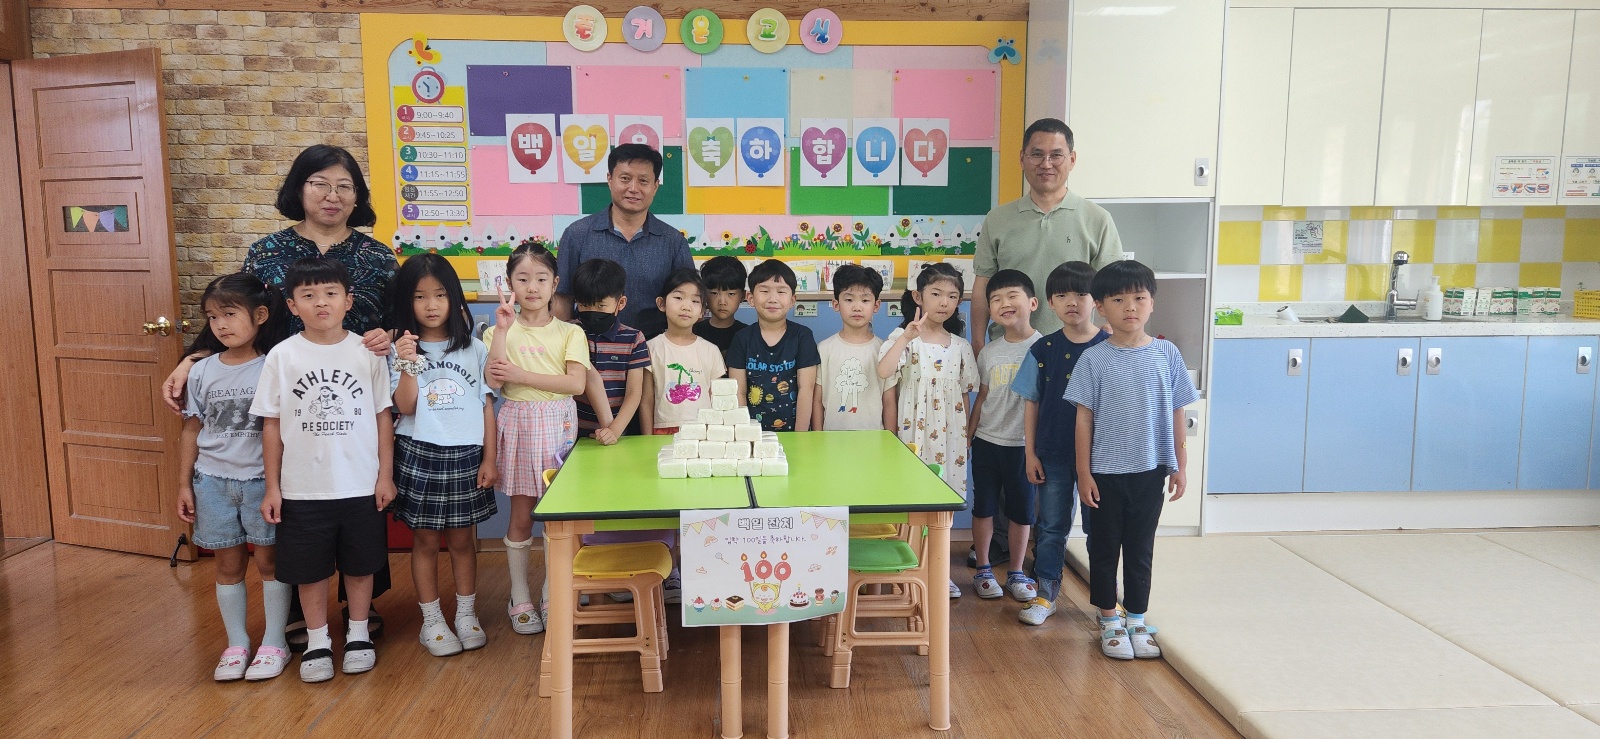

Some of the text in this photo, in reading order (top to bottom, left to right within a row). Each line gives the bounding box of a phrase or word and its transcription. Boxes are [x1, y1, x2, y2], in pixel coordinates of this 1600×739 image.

[746, 362, 768, 372] OLAR
[292, 368, 363, 400] ATHLETIC
[208, 388, 238, 399] GREAT
[294, 408, 302, 417] 19
[316, 420, 355, 432] SOCIETY
[737, 516, 794, 531] 백일 잔치
[740, 559, 792, 583] 100
